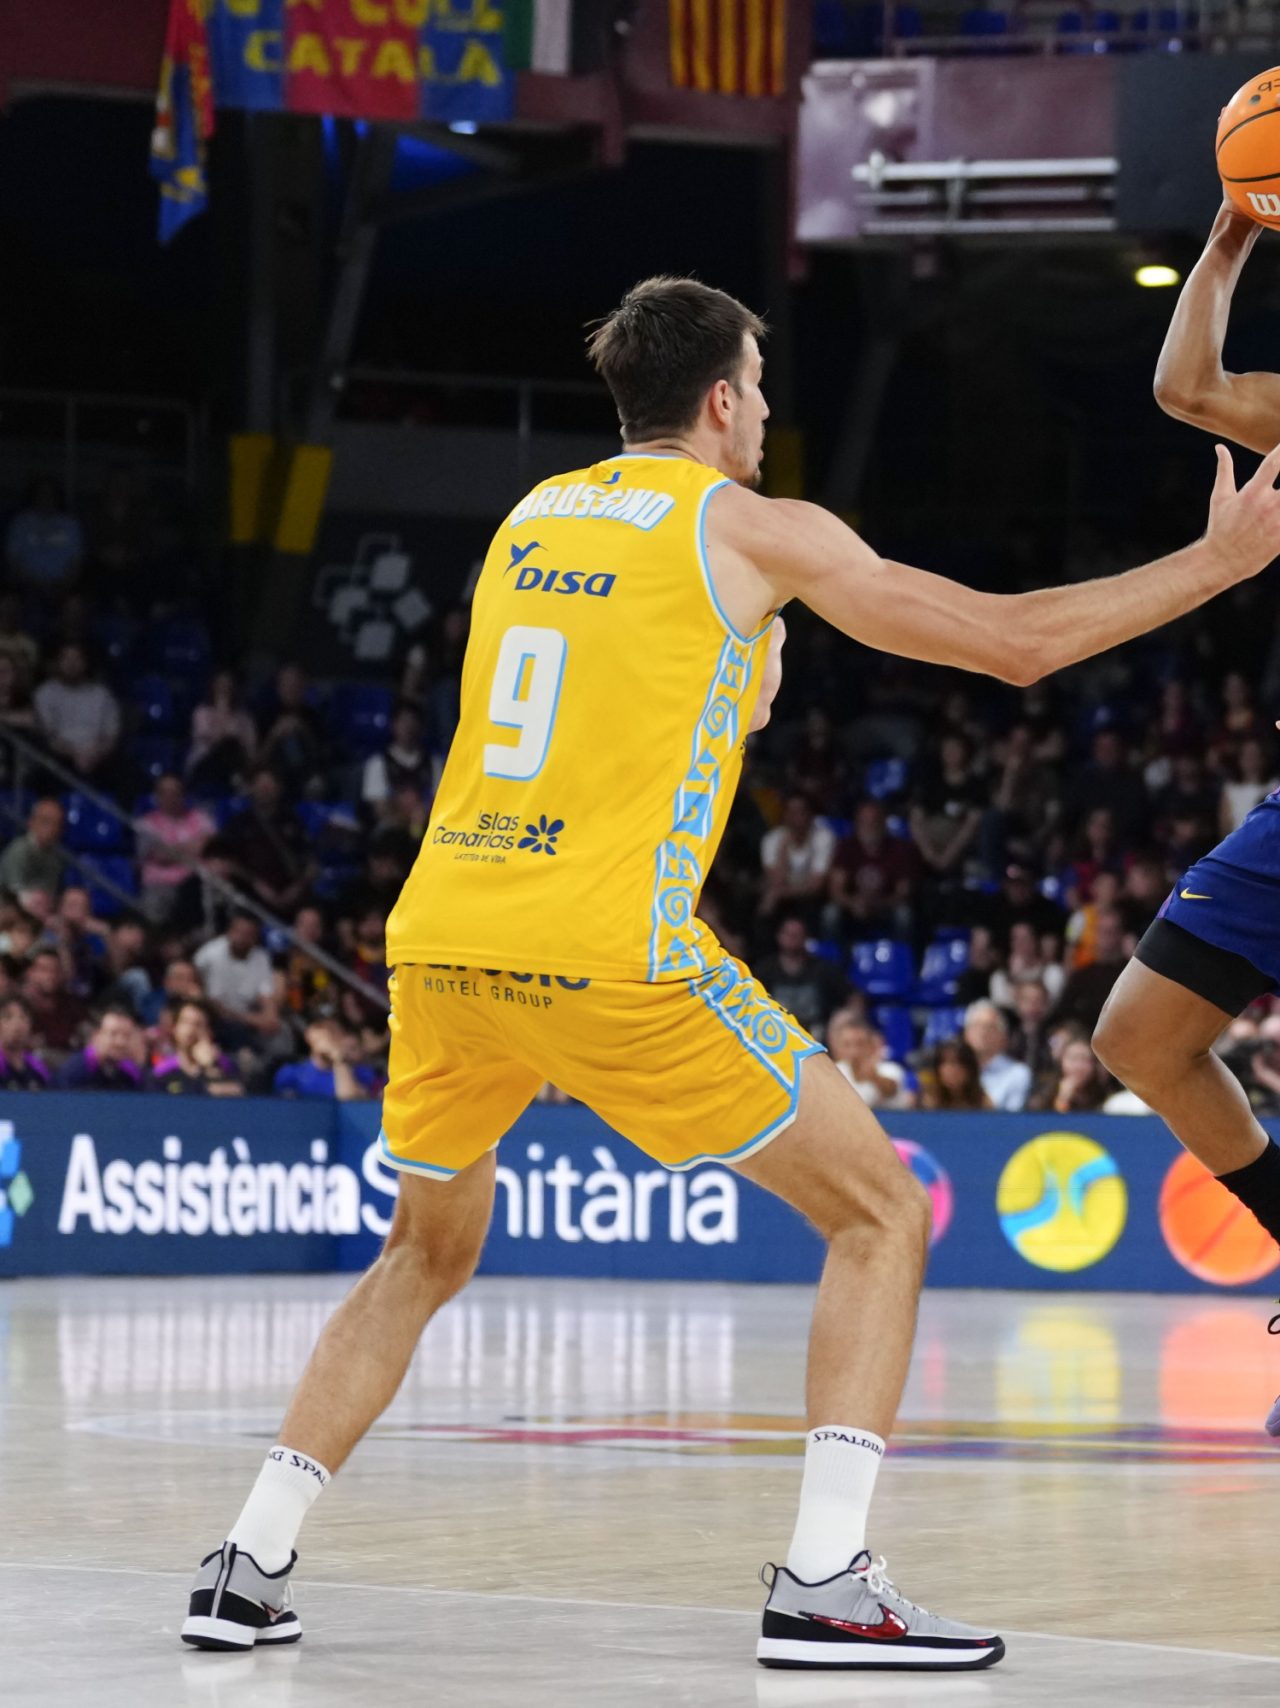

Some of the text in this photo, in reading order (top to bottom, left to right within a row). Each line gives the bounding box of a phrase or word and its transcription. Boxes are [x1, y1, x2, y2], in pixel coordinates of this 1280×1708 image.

[484, 625, 567, 782] 9
[432, 826, 514, 849] Canarias
[424, 976, 480, 997] HOTEL
[490, 985, 553, 1010] GROUP
[57, 1133, 739, 1245] Assistència Snitària
